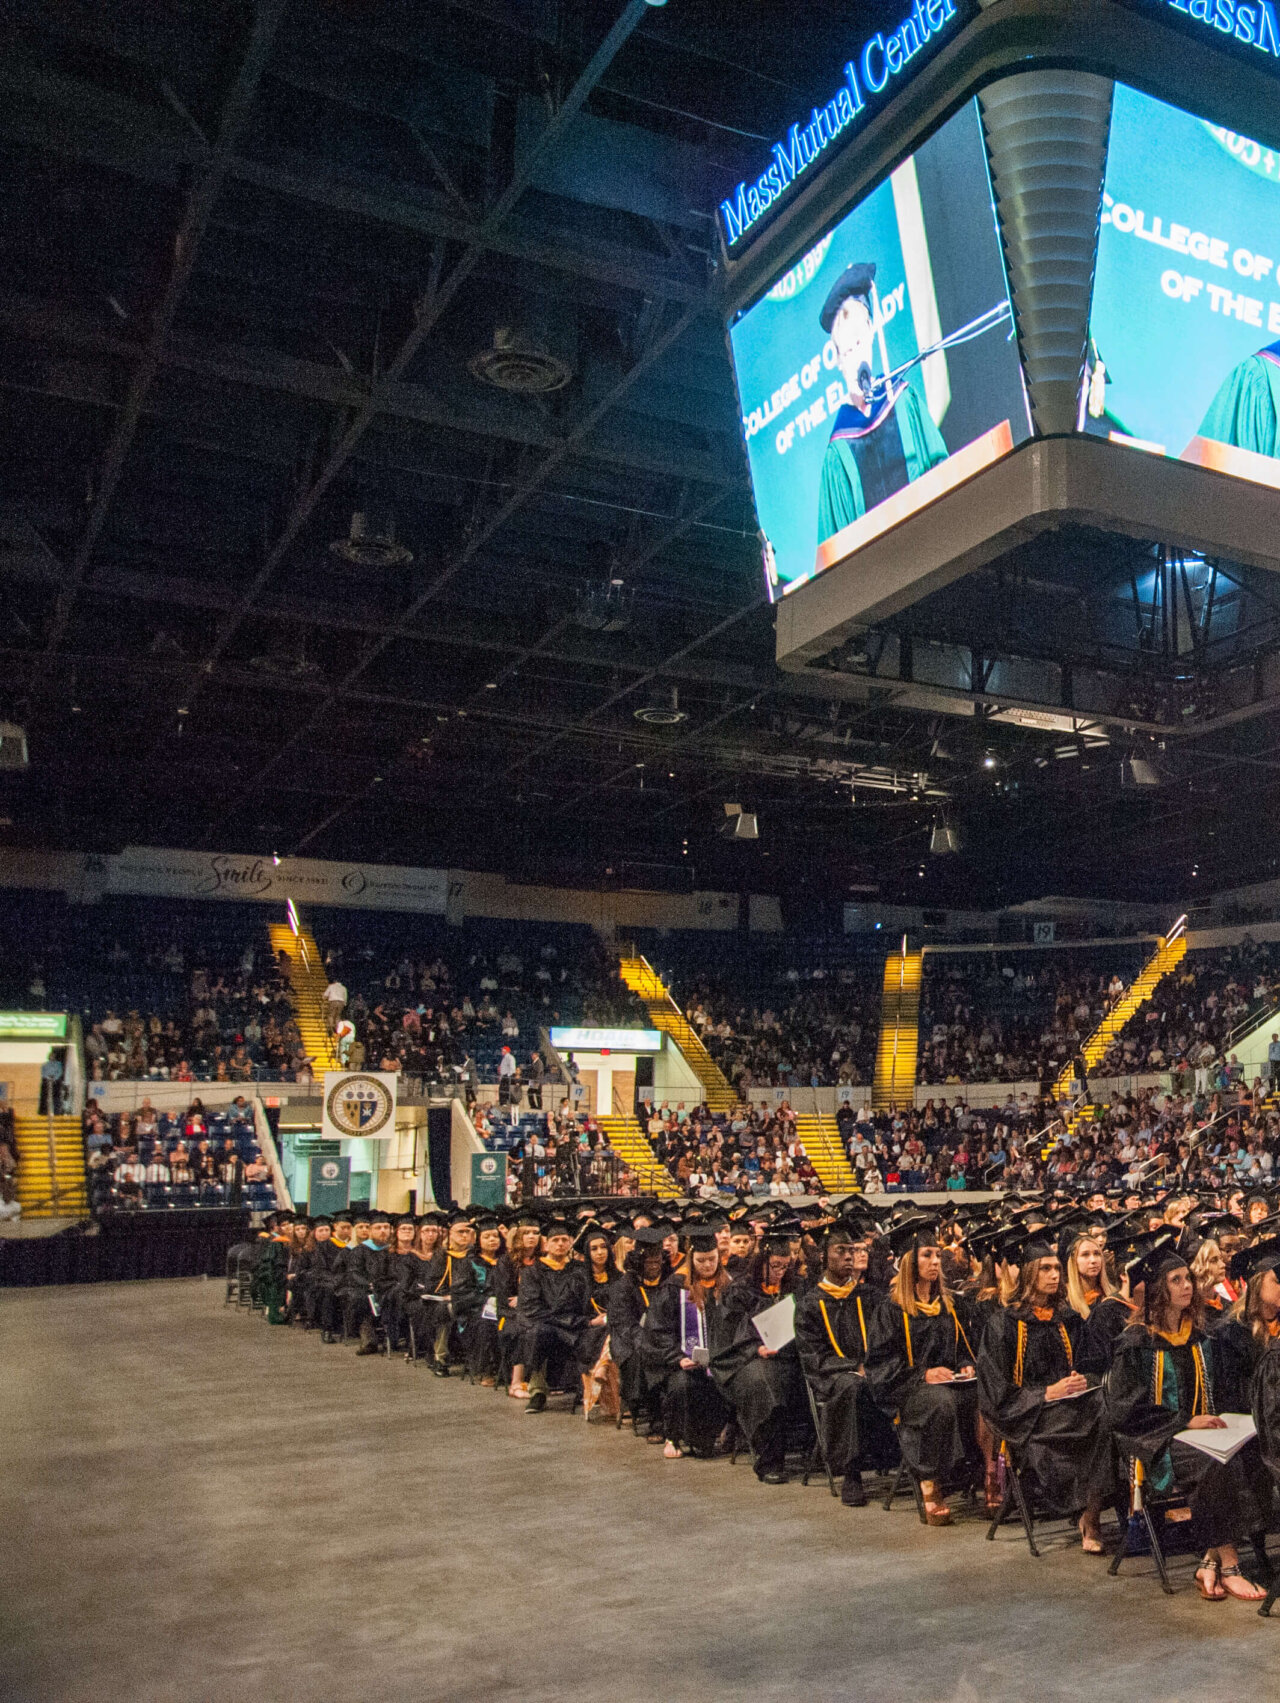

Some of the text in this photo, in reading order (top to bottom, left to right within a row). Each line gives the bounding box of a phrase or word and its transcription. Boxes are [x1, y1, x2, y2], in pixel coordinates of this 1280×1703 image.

[720, 0, 957, 245] MassMutual Center
[1233, 248, 1273, 281] OF
[1160, 269, 1204, 303] OF
[1206, 282, 1262, 328] THE
[801, 354, 822, 390] OF
[775, 427, 795, 455] OF
[795, 397, 826, 438] THE
[199, 856, 277, 894] Smile
